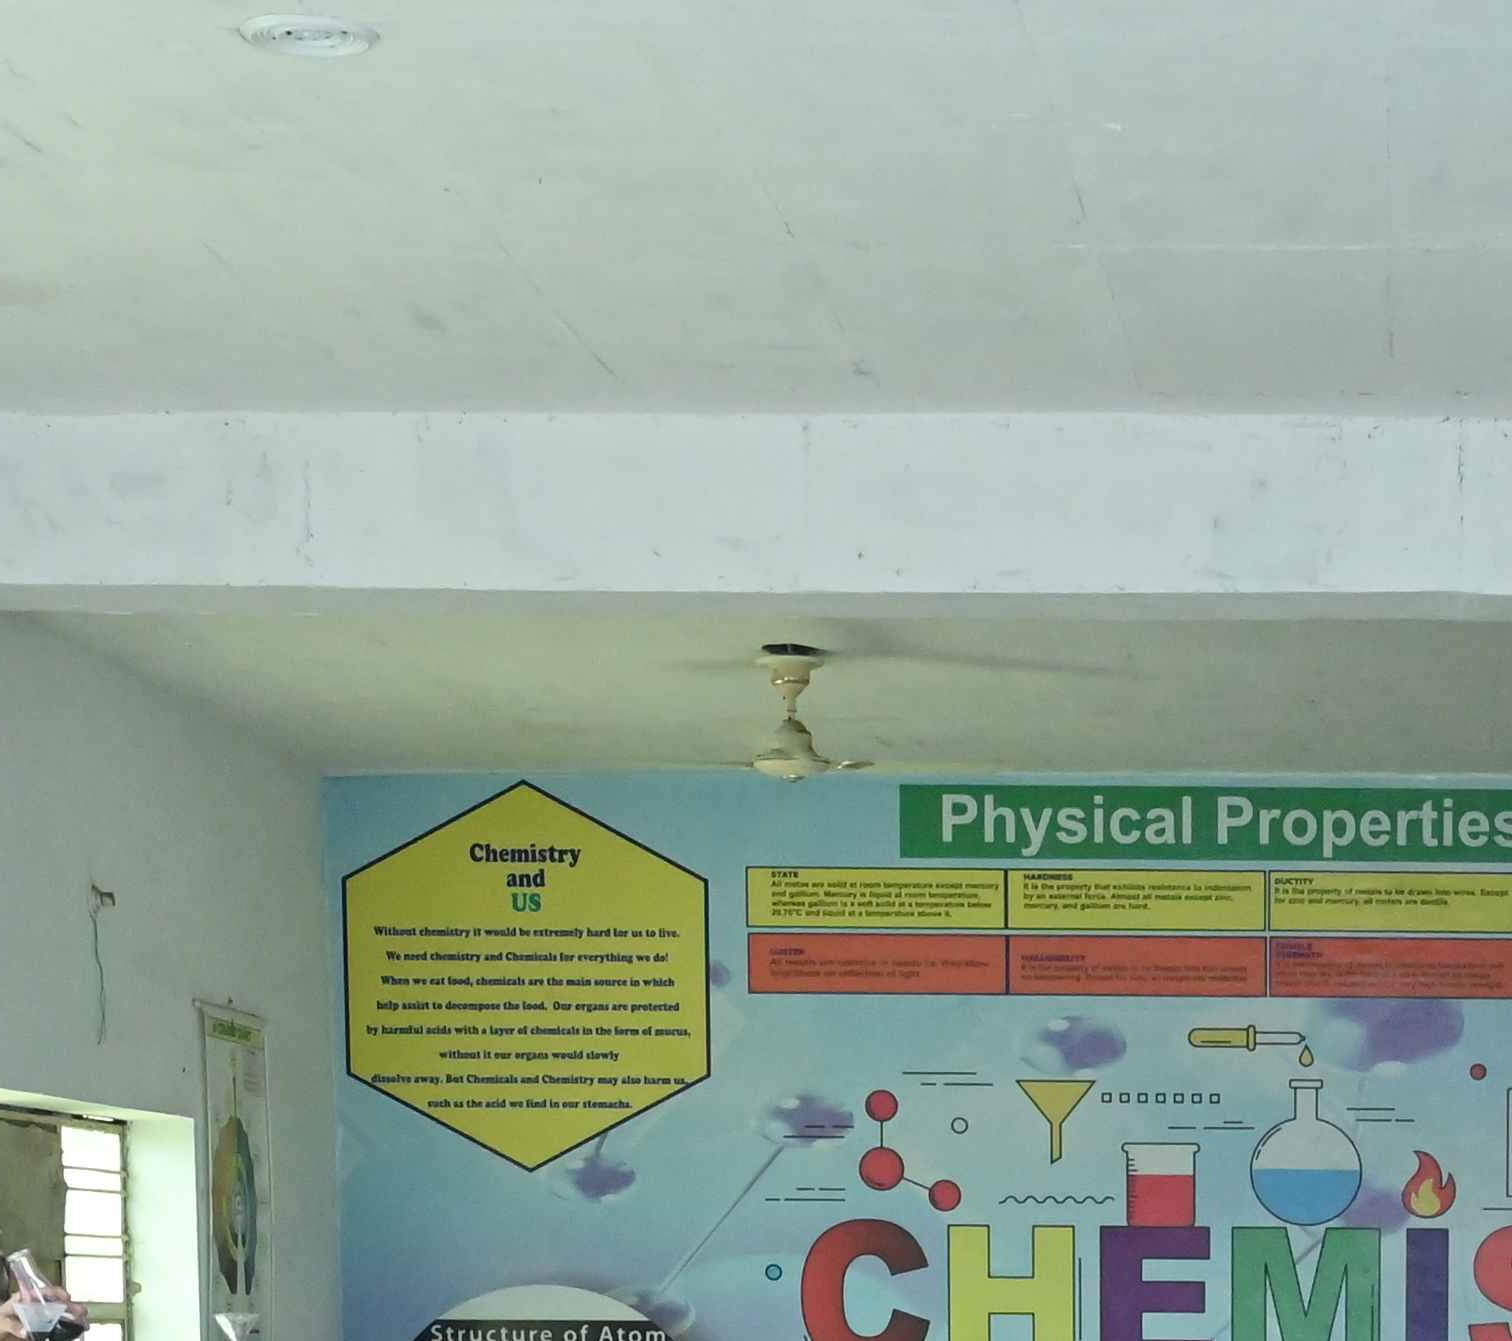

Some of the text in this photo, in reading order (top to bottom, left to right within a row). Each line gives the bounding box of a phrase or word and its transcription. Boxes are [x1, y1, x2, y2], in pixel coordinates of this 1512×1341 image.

[941, 794, 1192, 857] Physical
[469, 843, 581, 867] Chemistry
[506, 868, 546, 888] and
[511, 892, 541, 912] US
[374, 926, 416, 936] Without
[419, 926, 470, 938] chemistry
[484, 927, 516, 936] would
[518, 927, 530, 936] be
[533, 927, 584, 939] extremely
[586, 927, 610, 937] hard
[613, 927, 628, 937] for
[645, 929, 656, 937] to
[386, 951, 401, 960] We
[404, 951, 427, 961] need
[430, 952, 481, 962] chemistry
[484, 952, 502, 961] and
[505, 951, 557, 961] Chemicals
[559, 952, 575, 962] for
[380, 975, 409, 985] When
[429, 977, 445, 985] eat
[476, 976, 525, 985] chemicals
[528, 978, 544, 986] are
[546, 976, 563, 986] the
[566, 977, 591, 986] main
[630, 977, 640, 987] in
[642, 977, 674, 986] which
[376, 1000, 399, 1011] help
[445, 1000, 500, 1012] decompose
[503, 1000, 520, 1010] the
[552, 1001, 572, 1010] Our
[574, 1003, 609, 1013] organs
[630, 1002, 679, 1013] protected
[366, 1025, 378, 1036] by
[426, 1025, 451, 1034] acids
[454, 1025, 479, 1034] with
[517, 1025, 528, 1035] of
[530, 1025, 580, 1035] chemicals
[582, 1026, 592, 1035] in
[595, 1026, 612, 1035] the
[641, 1026, 652, 1036] of
[439, 1049, 480, 1059] without
[514, 1052, 548, 1061] organs
[551, 1050, 583, 1059] would
[446, 1073, 464, 1083] But
[466, 1074, 518, 1084] Chemicals
[520, 1075, 539, 1084] and
[541, 1074, 594, 1086] Chemistry
[597, 1077, 618, 1086] may
[644, 1075, 671, 1084] harm
